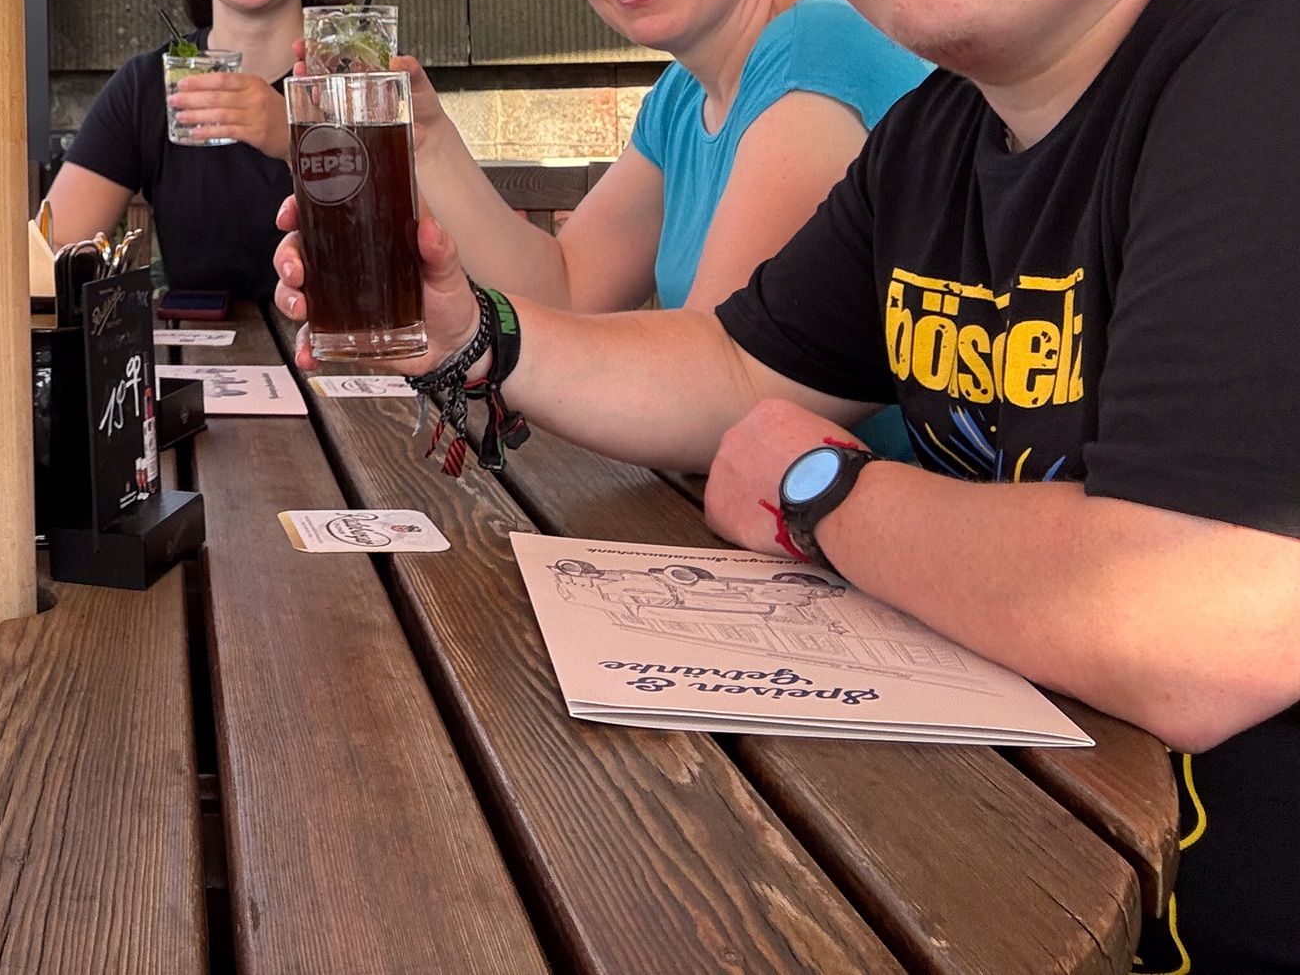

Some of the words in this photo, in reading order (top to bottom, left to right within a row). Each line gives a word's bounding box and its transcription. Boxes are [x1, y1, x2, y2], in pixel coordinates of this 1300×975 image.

[300, 153, 363, 175] PEPSI
[598, 659, 814, 686] Getränke
[626, 676, 677, 693] &
[688, 682, 880, 705] Speisen
